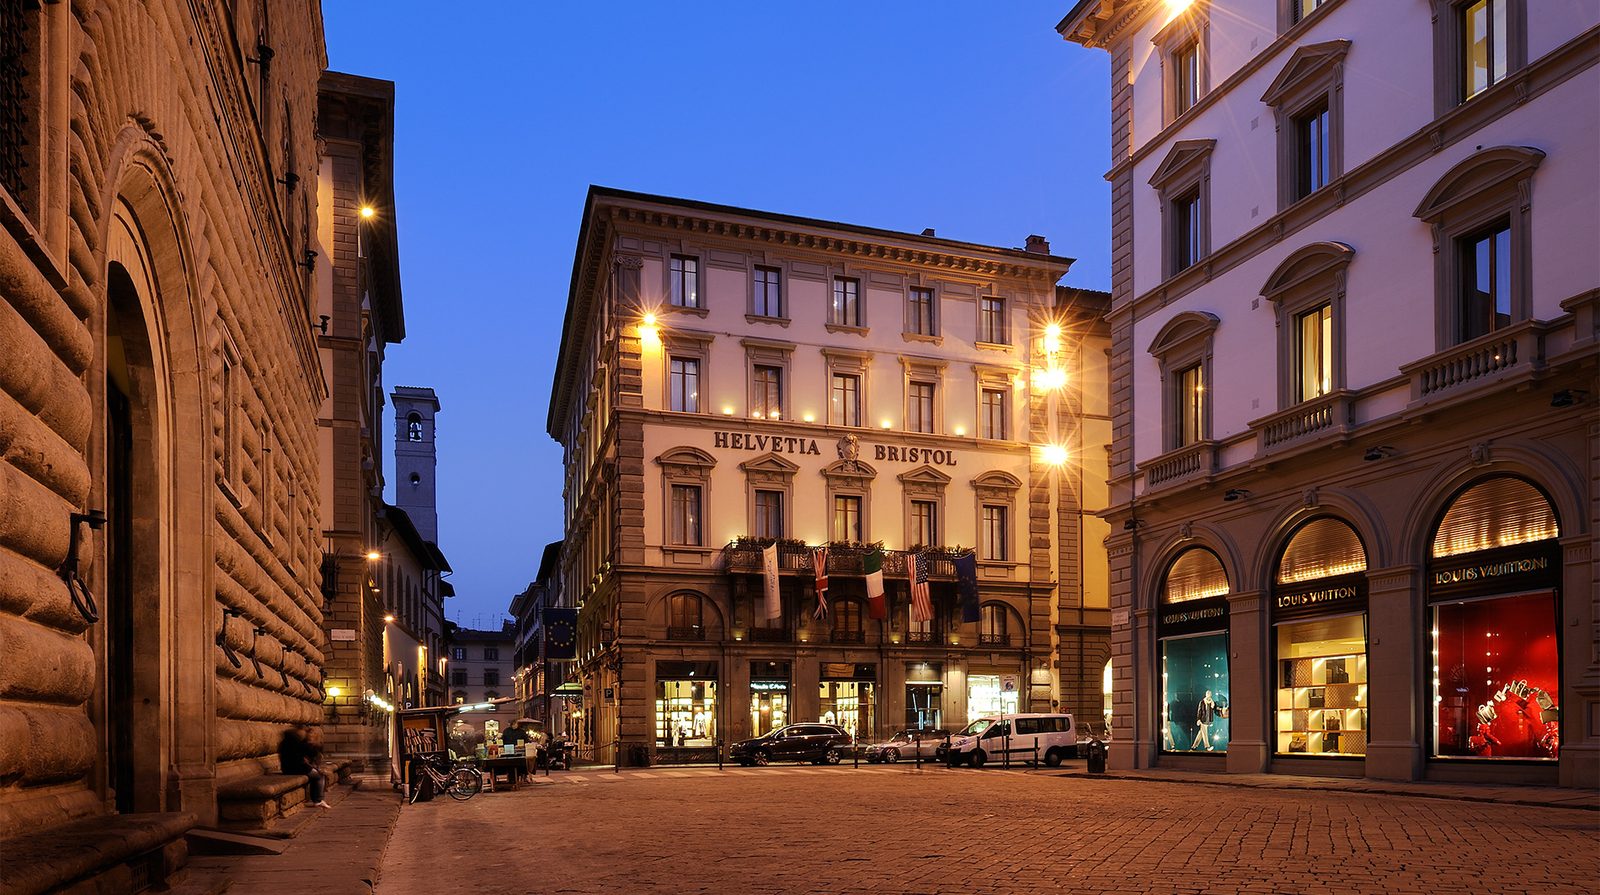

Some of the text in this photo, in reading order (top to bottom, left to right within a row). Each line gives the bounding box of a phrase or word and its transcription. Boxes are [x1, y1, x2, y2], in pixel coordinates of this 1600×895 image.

[714, 431, 957, 465] HELVETIA BRISTOL
[1436, 557, 1547, 584] LOUIS VUITTON
[1278, 586, 1356, 608] LOUIS VUITTON
